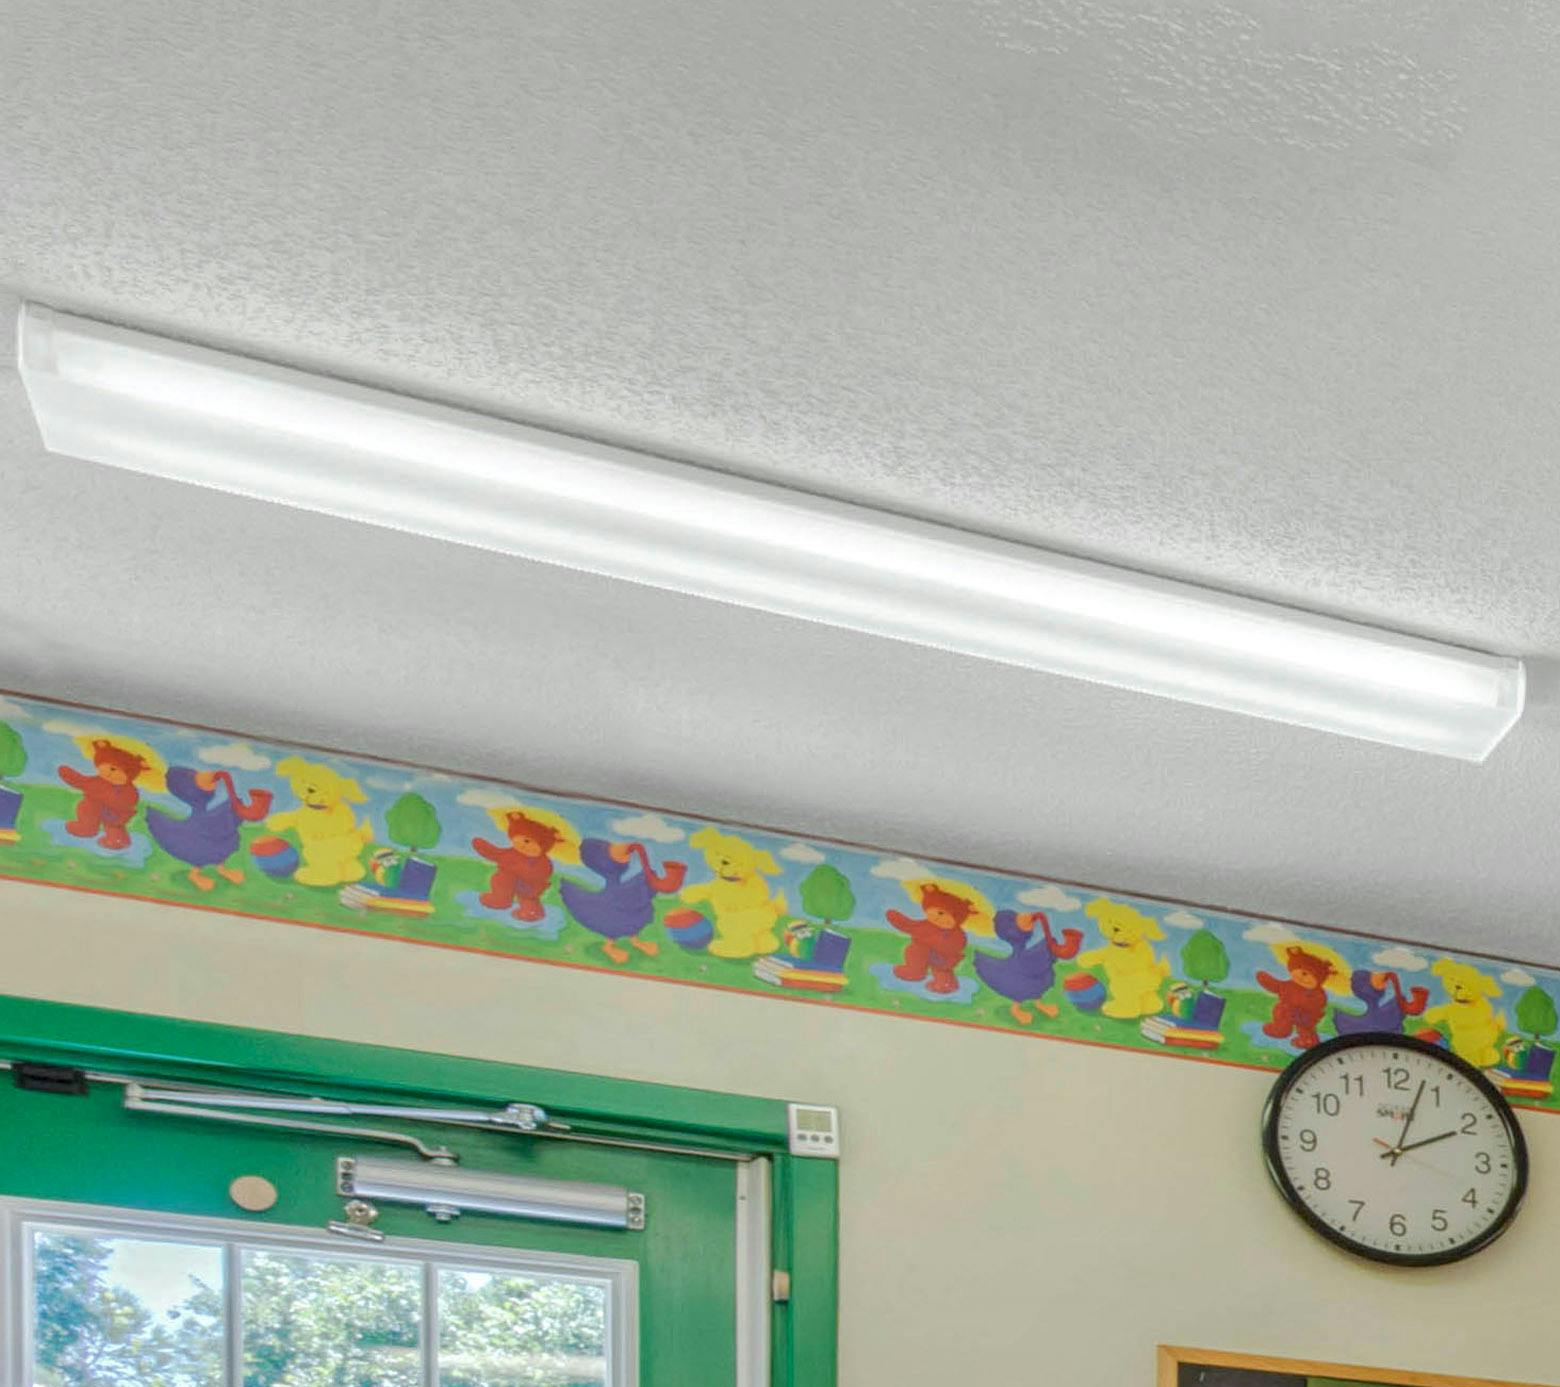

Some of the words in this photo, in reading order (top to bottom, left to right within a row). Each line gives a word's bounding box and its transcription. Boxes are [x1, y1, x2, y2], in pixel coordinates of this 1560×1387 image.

[1340, 1074, 1365, 1097] 11
[1383, 1067, 1410, 1091] 12
[1312, 1093, 1341, 1117] 10
[1431, 1086, 1441, 1107] 1
[1461, 1112, 1478, 1135] 2
[1299, 1129, 1318, 1151] 9
[1474, 1152, 1492, 1174] 3
[1313, 1167, 1332, 1191] 8
[1461, 1187, 1479, 1209] 4
[1347, 1200, 1366, 1222] 7
[1430, 1209, 1449, 1232] 5
[1388, 1213, 1408, 1237] 6
